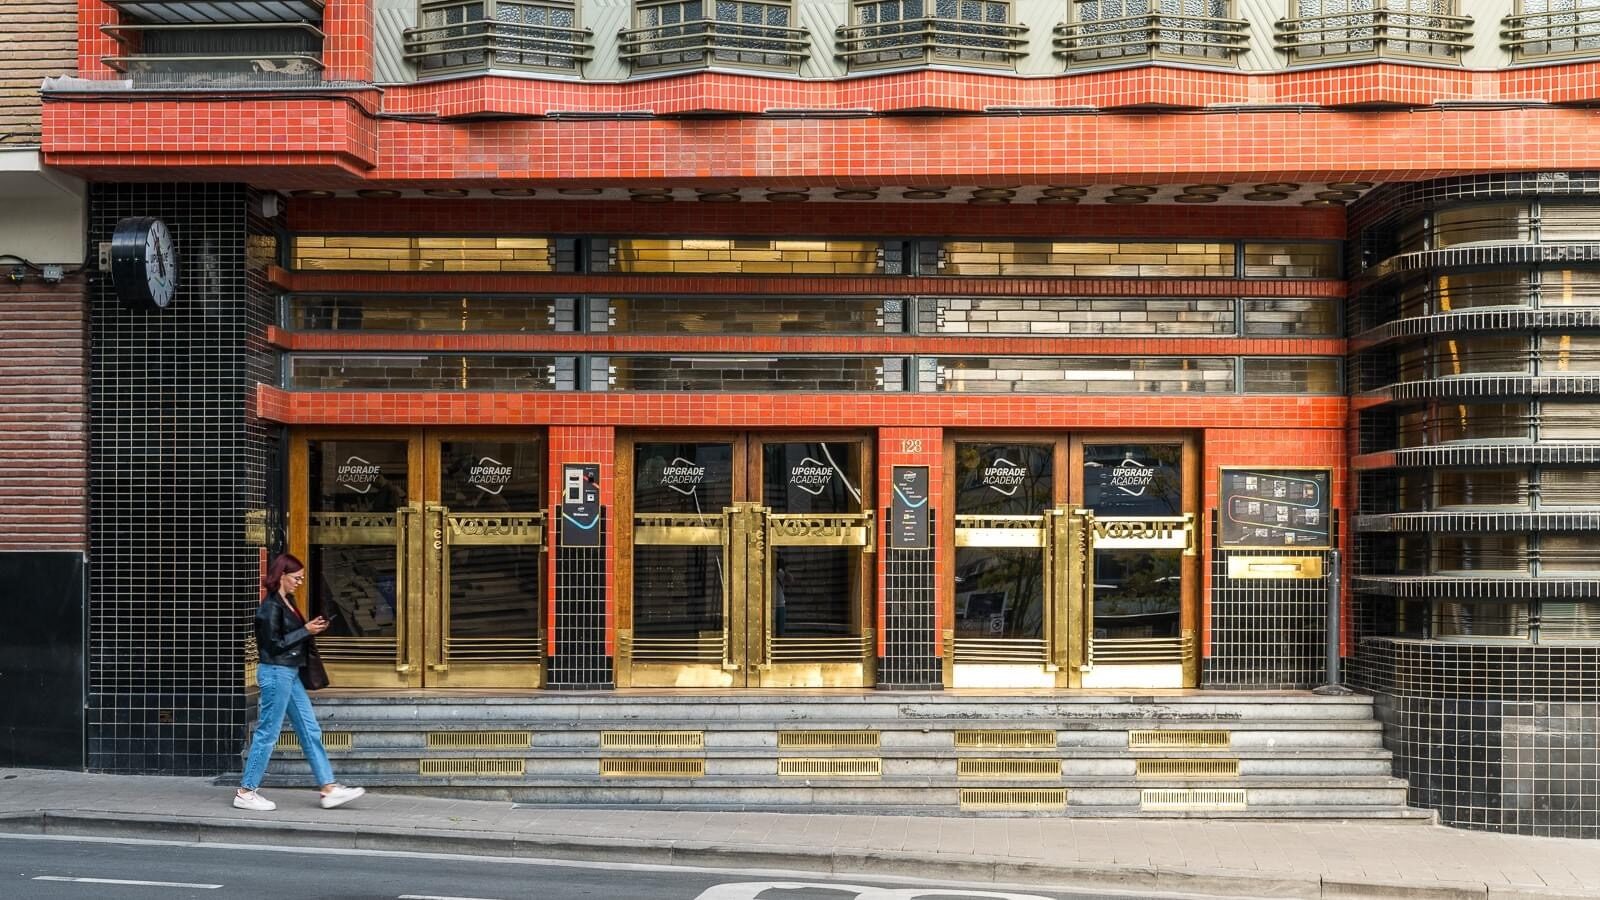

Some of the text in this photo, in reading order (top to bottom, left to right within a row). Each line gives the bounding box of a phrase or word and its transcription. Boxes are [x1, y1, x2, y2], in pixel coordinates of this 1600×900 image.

[902, 439, 922, 454] 128
[338, 466, 380, 474] UPGRADE
[792, 468, 833, 476] UPGRADE
[984, 468, 1026, 476] UPGRADE
[1112, 468, 1154, 476] UPGRADE
[661, 476, 703, 484] ACADEMY
[790, 476, 831, 484] ACADEMY
[982, 476, 1024, 484] ACADEMY
[1110, 477, 1152, 485] ACADEMY
